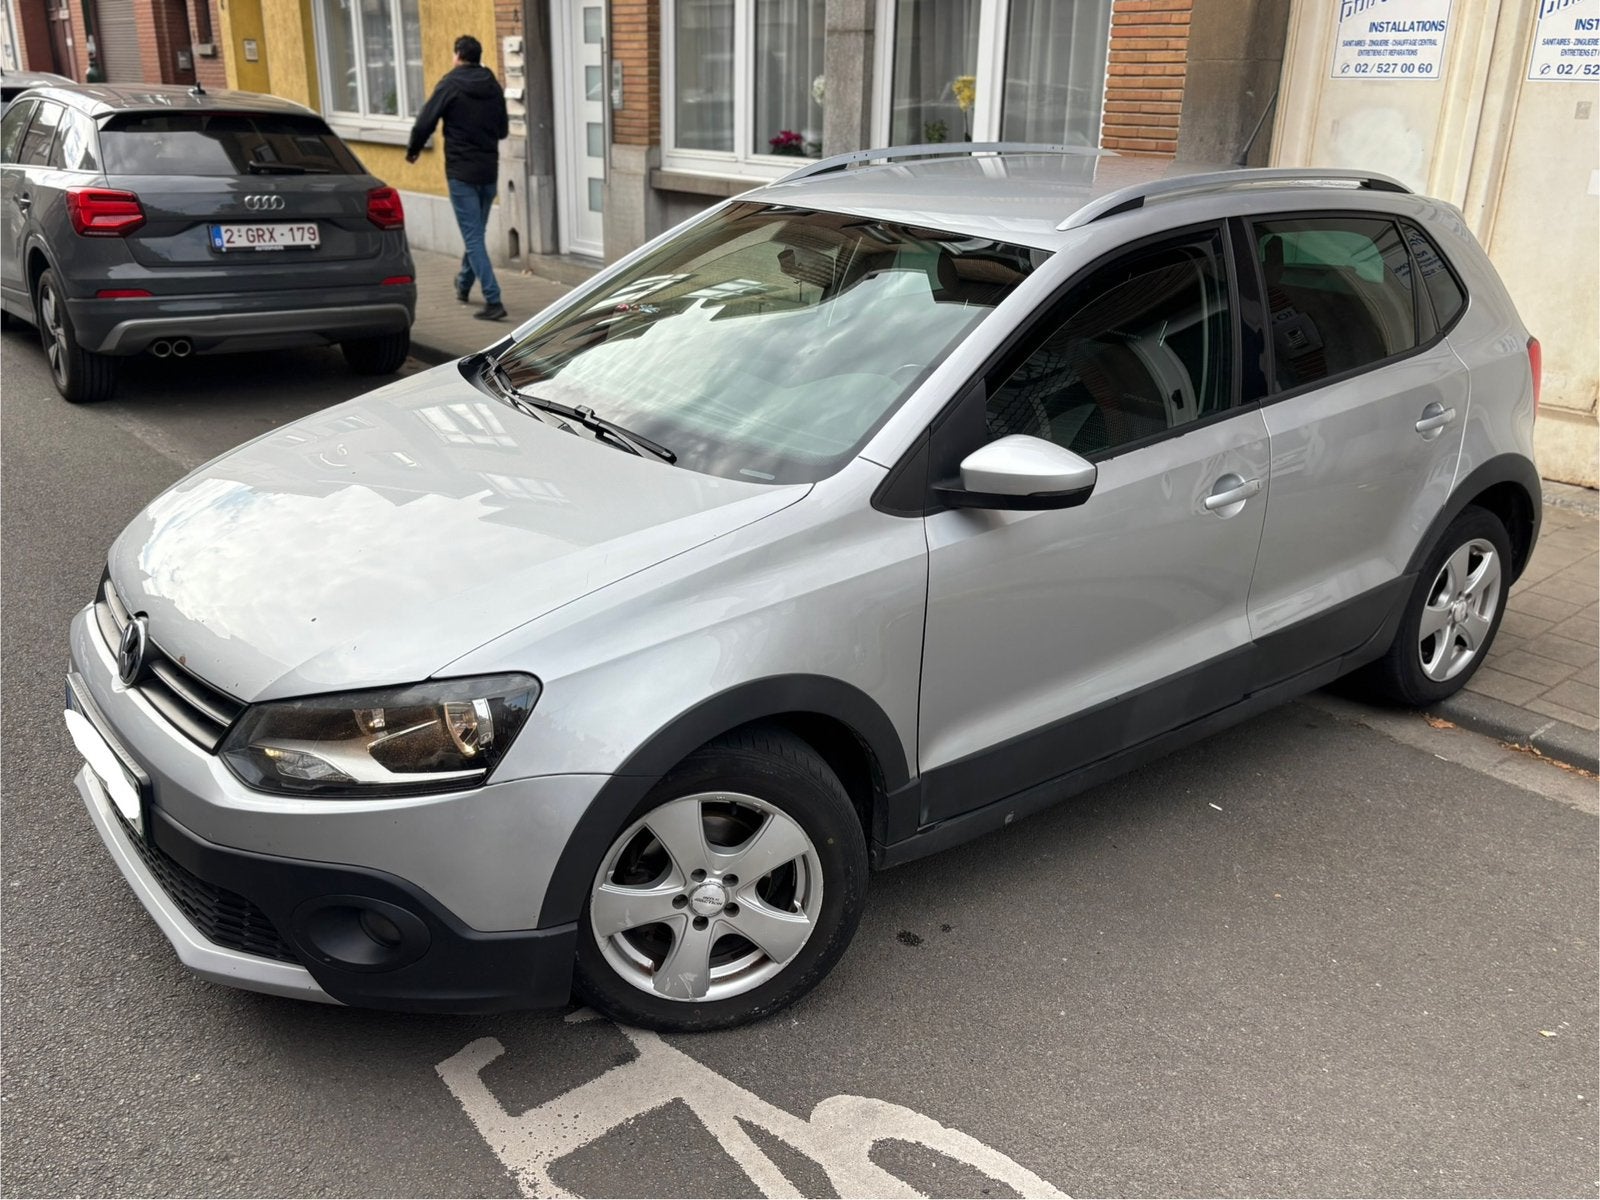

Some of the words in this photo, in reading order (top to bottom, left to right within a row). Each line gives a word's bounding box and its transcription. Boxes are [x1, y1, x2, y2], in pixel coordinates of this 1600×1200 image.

[1369, 20, 1446, 33] INSTALLATIONS
[1418, 38, 1438, 47] CENTRAL
[1400, 62, 1415, 74] 00
[1417, 62, 1433, 74] 60
